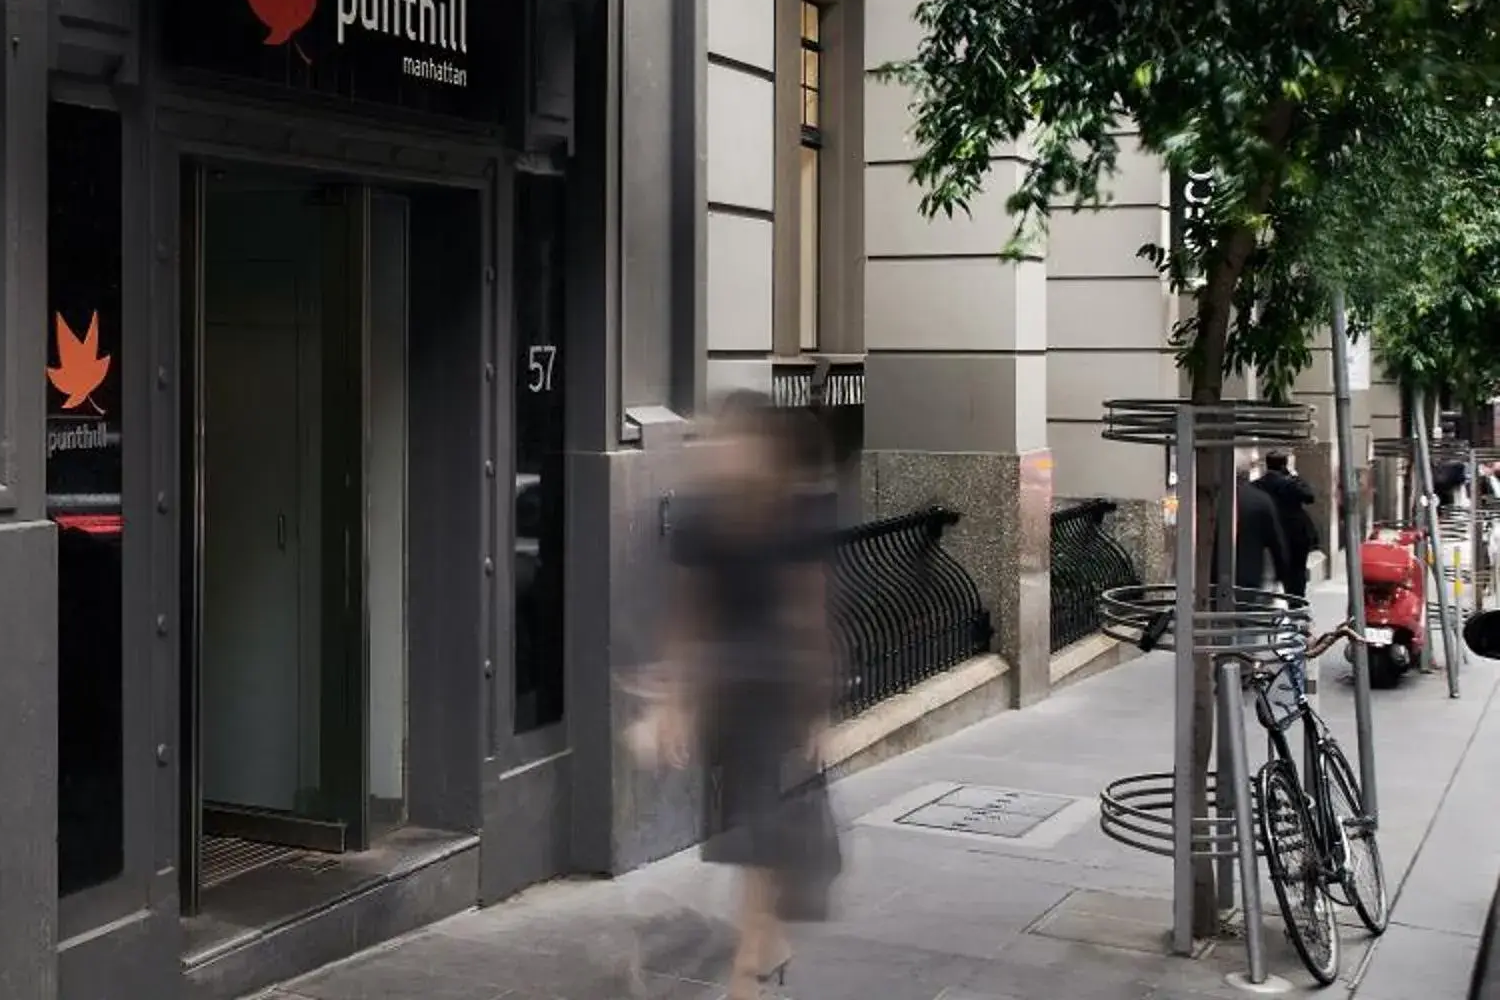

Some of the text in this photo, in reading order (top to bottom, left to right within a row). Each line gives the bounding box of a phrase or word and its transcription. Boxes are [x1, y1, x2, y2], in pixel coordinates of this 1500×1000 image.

[403, 56, 467, 87] manhattan
[528, 345, 557, 393] 57
[48, 421, 107, 459] punthill
